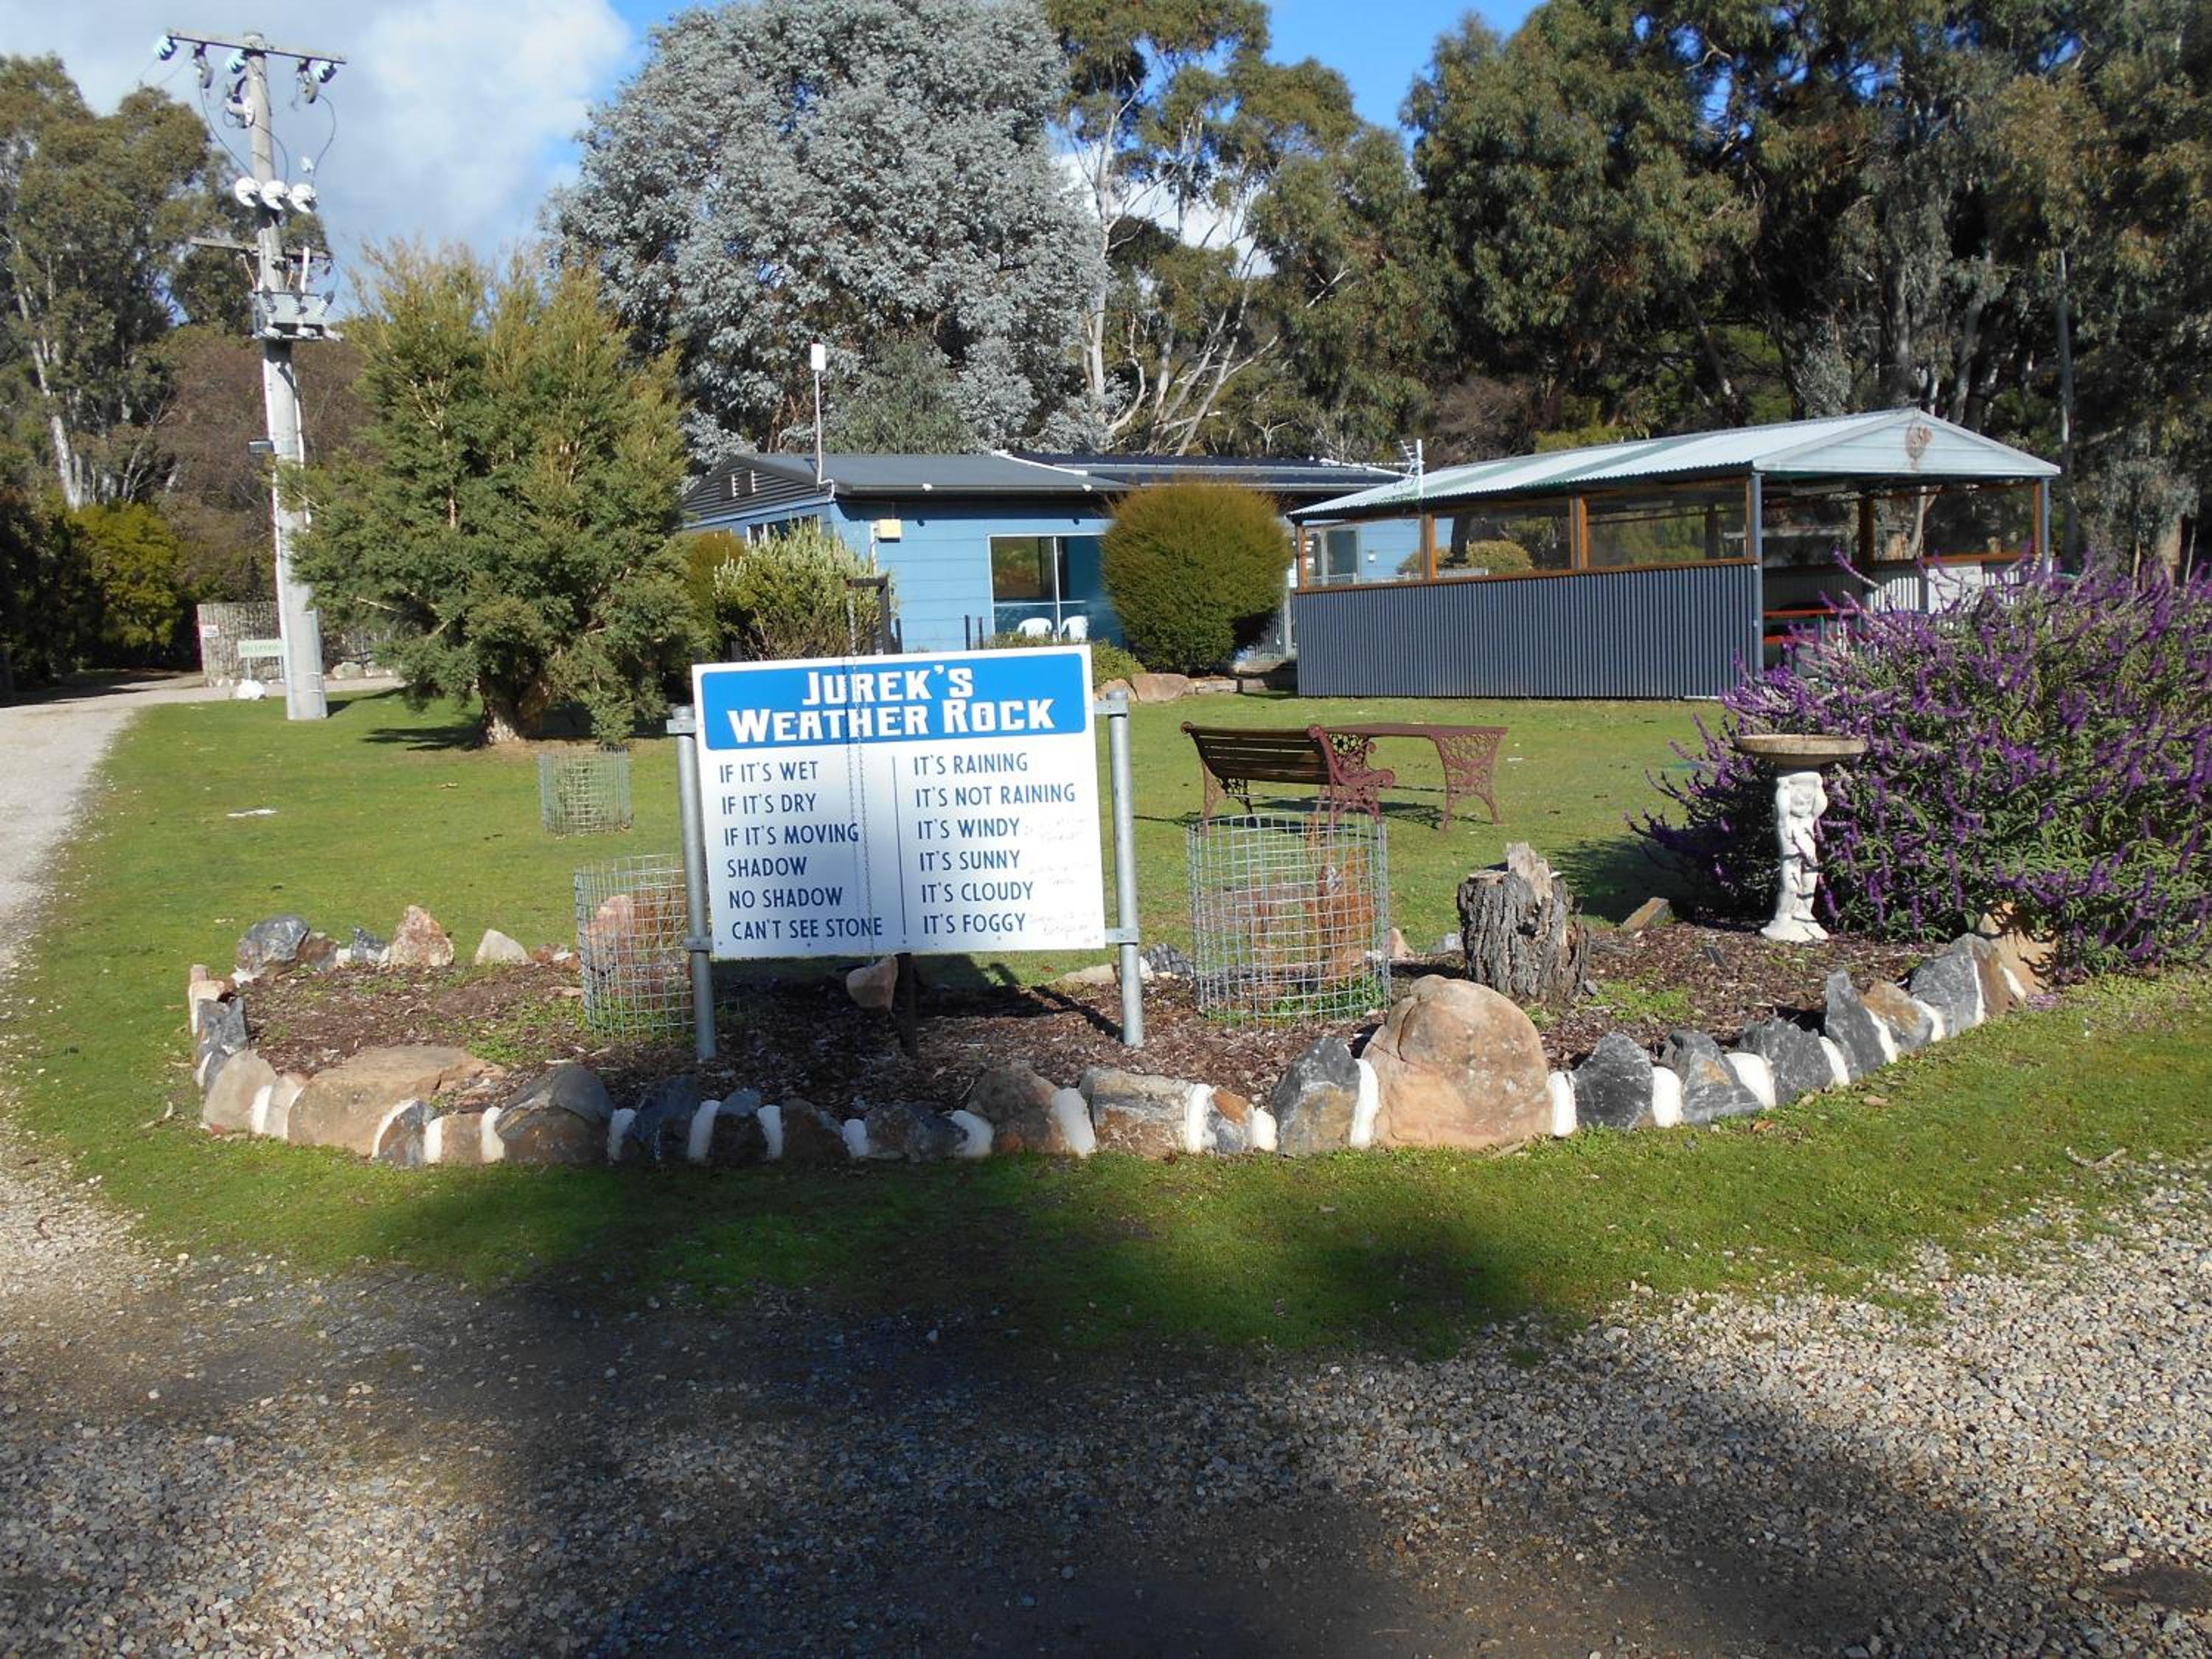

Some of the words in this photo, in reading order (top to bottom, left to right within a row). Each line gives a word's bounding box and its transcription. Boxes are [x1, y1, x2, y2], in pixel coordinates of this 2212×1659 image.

[801, 665, 973, 706] JUREK'S
[727, 705, 929, 743] WEATHER
[945, 698, 1055, 734] ROCK
[720, 765, 733, 783] IF
[741, 762, 771, 782] IT'S
[780, 762, 817, 781] WET
[914, 755, 945, 776] IT'S
[953, 753, 1027, 774] RAINING
[723, 796, 736, 814] IF
[743, 795, 774, 814] IT'S
[782, 793, 815, 813] DRY
[917, 787, 947, 807] IT'S
[956, 787, 991, 806] NOT
[1001, 783, 1074, 804] RAINING
[725, 828, 738, 846] IF
[746, 826, 776, 846] IT'S
[785, 823, 858, 844] MOVING
[918, 819, 950, 839] IT'S
[957, 818, 1019, 838] WINDY
[728, 856, 807, 877] SHADOW
[920, 851, 951, 872] IT'S
[959, 850, 1019, 870] SUNNY
[730, 891, 755, 908] NO
[763, 886, 843, 908] SHADOW
[922, 883, 953, 903] IT'S
[961, 882, 1032, 902] CLOUDY
[732, 919, 782, 939] CAN'T
[790, 919, 819, 938] SEE
[826, 917, 882, 937] STONE
[924, 914, 955, 934] IT'S
[962, 914, 1025, 933] FOGGY
